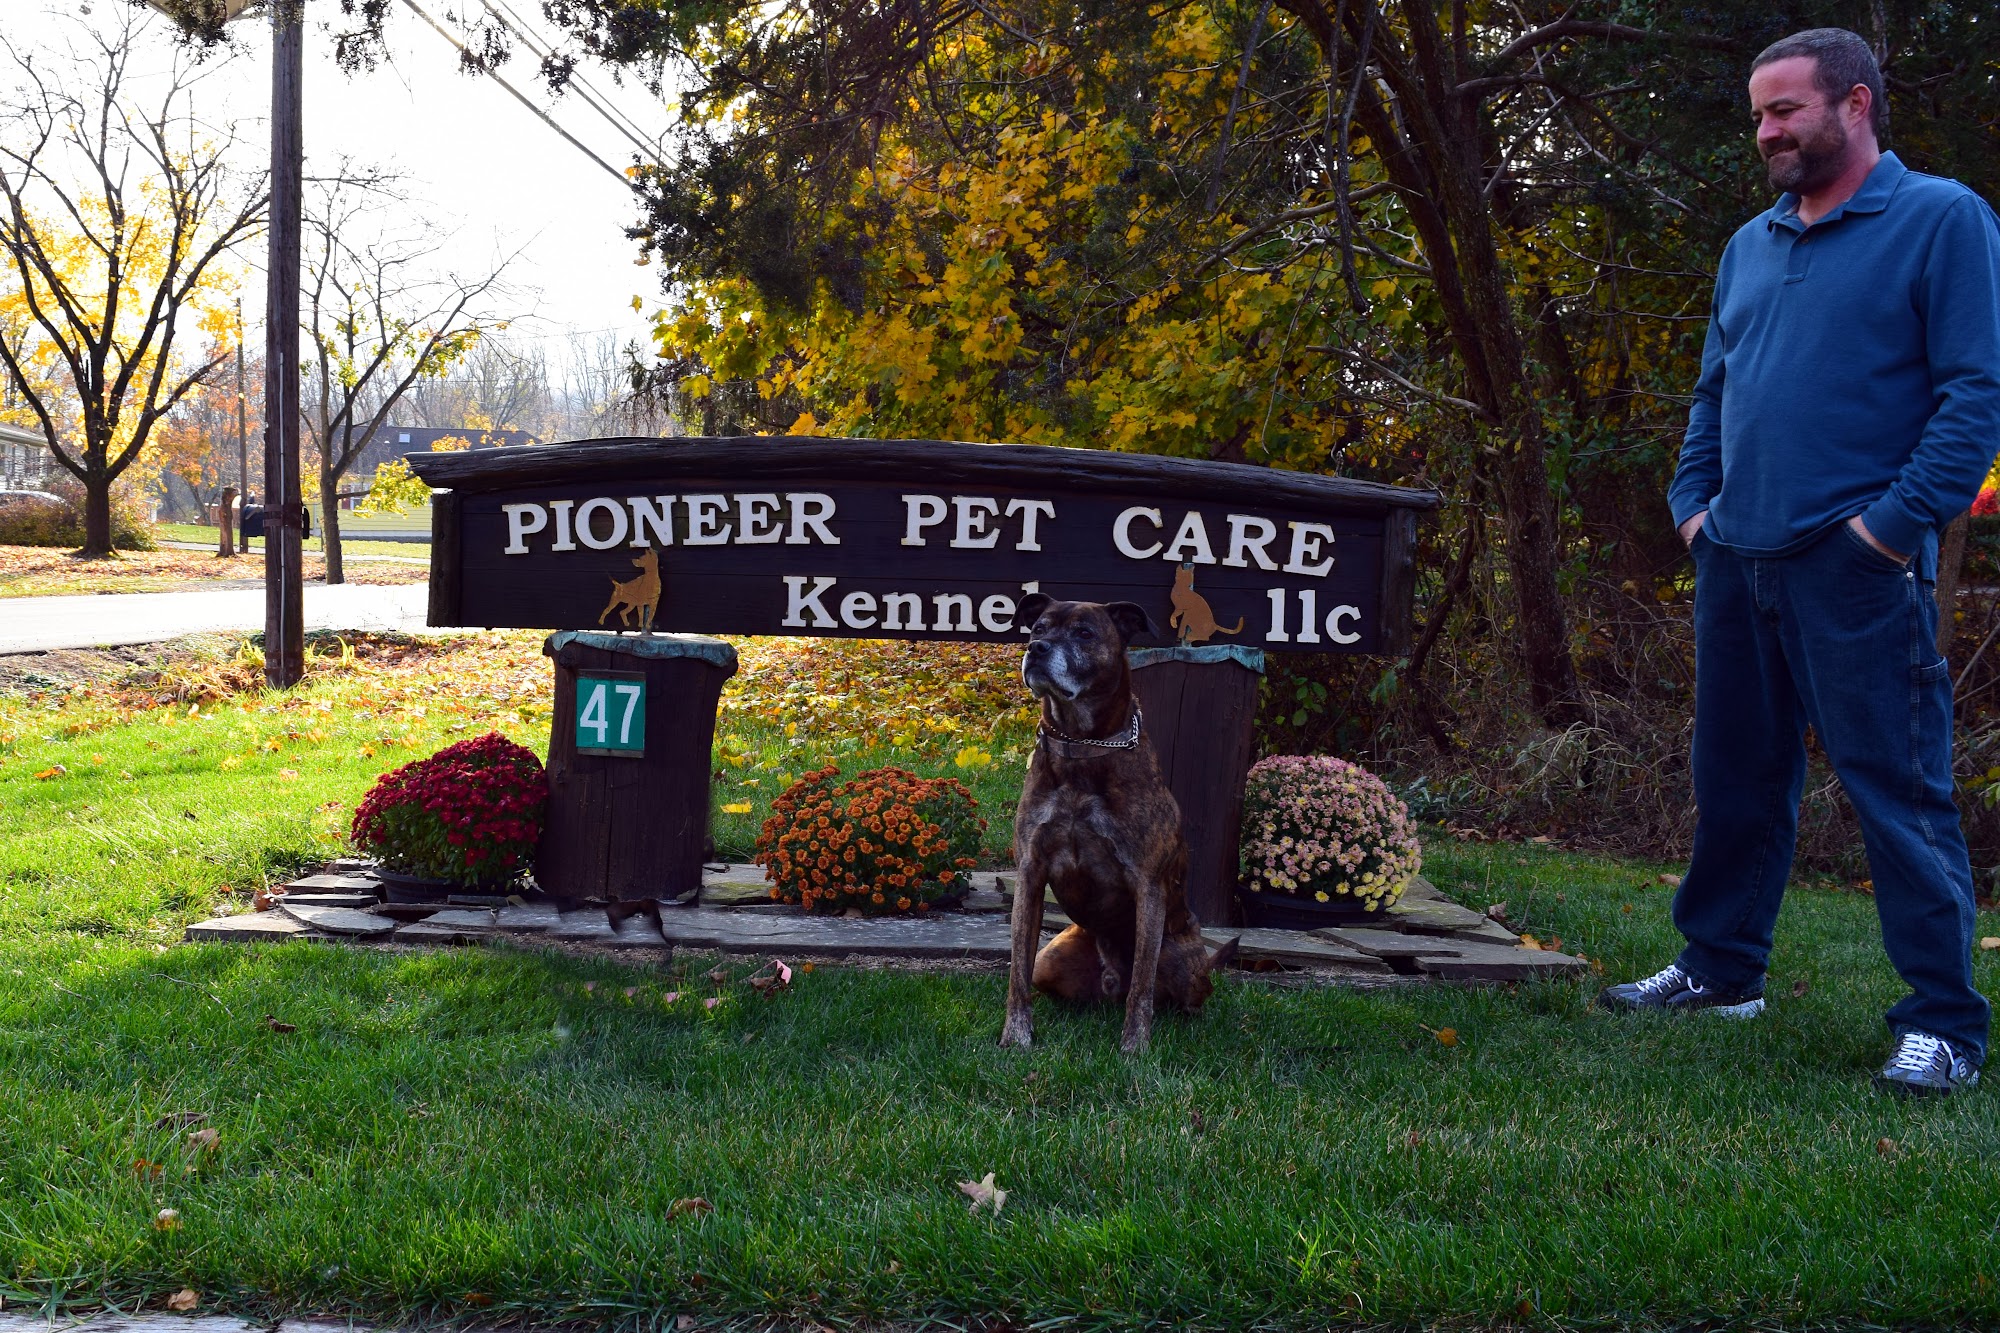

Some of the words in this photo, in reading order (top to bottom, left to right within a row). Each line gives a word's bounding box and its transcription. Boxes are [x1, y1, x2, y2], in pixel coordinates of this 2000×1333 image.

[502, 493, 840, 554] PIONEER
[901, 495, 1056, 551] PET
[1113, 507, 1335, 577] CARE
[1266, 588, 1362, 644] llc
[580, 684, 641, 744] 47
